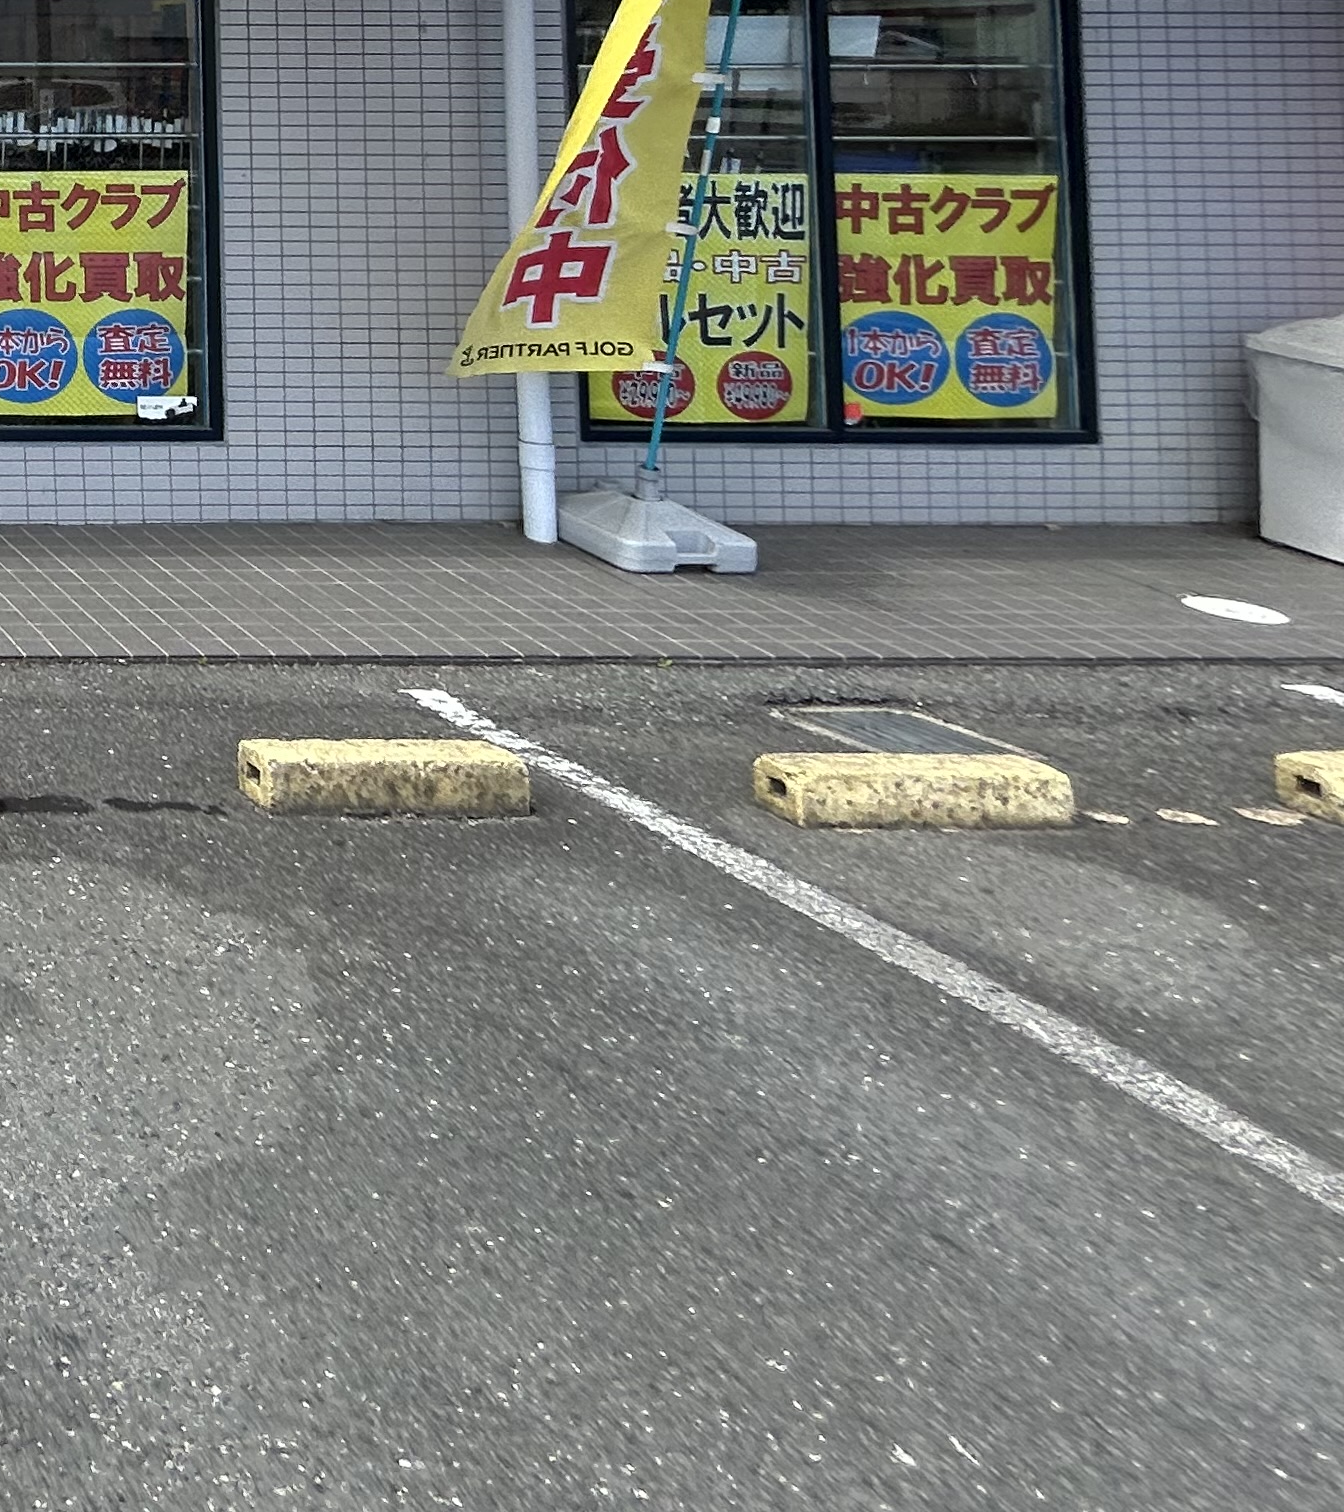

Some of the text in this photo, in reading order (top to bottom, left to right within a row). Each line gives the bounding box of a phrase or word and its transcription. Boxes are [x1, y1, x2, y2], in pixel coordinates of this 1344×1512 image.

[836, 182, 1056, 235] 中古クラブ
[838, 252, 1053, 306] 強化買取
[95, 322, 171, 356] 査定
[846, 327, 942, 358] 1本から
[966, 326, 1041, 359] 査定
[98, 357, 174, 391] 無料
[729, 361, 785, 379] 新品
[853, 359, 938, 392] OK!
[969, 362, 1045, 395] 無料
